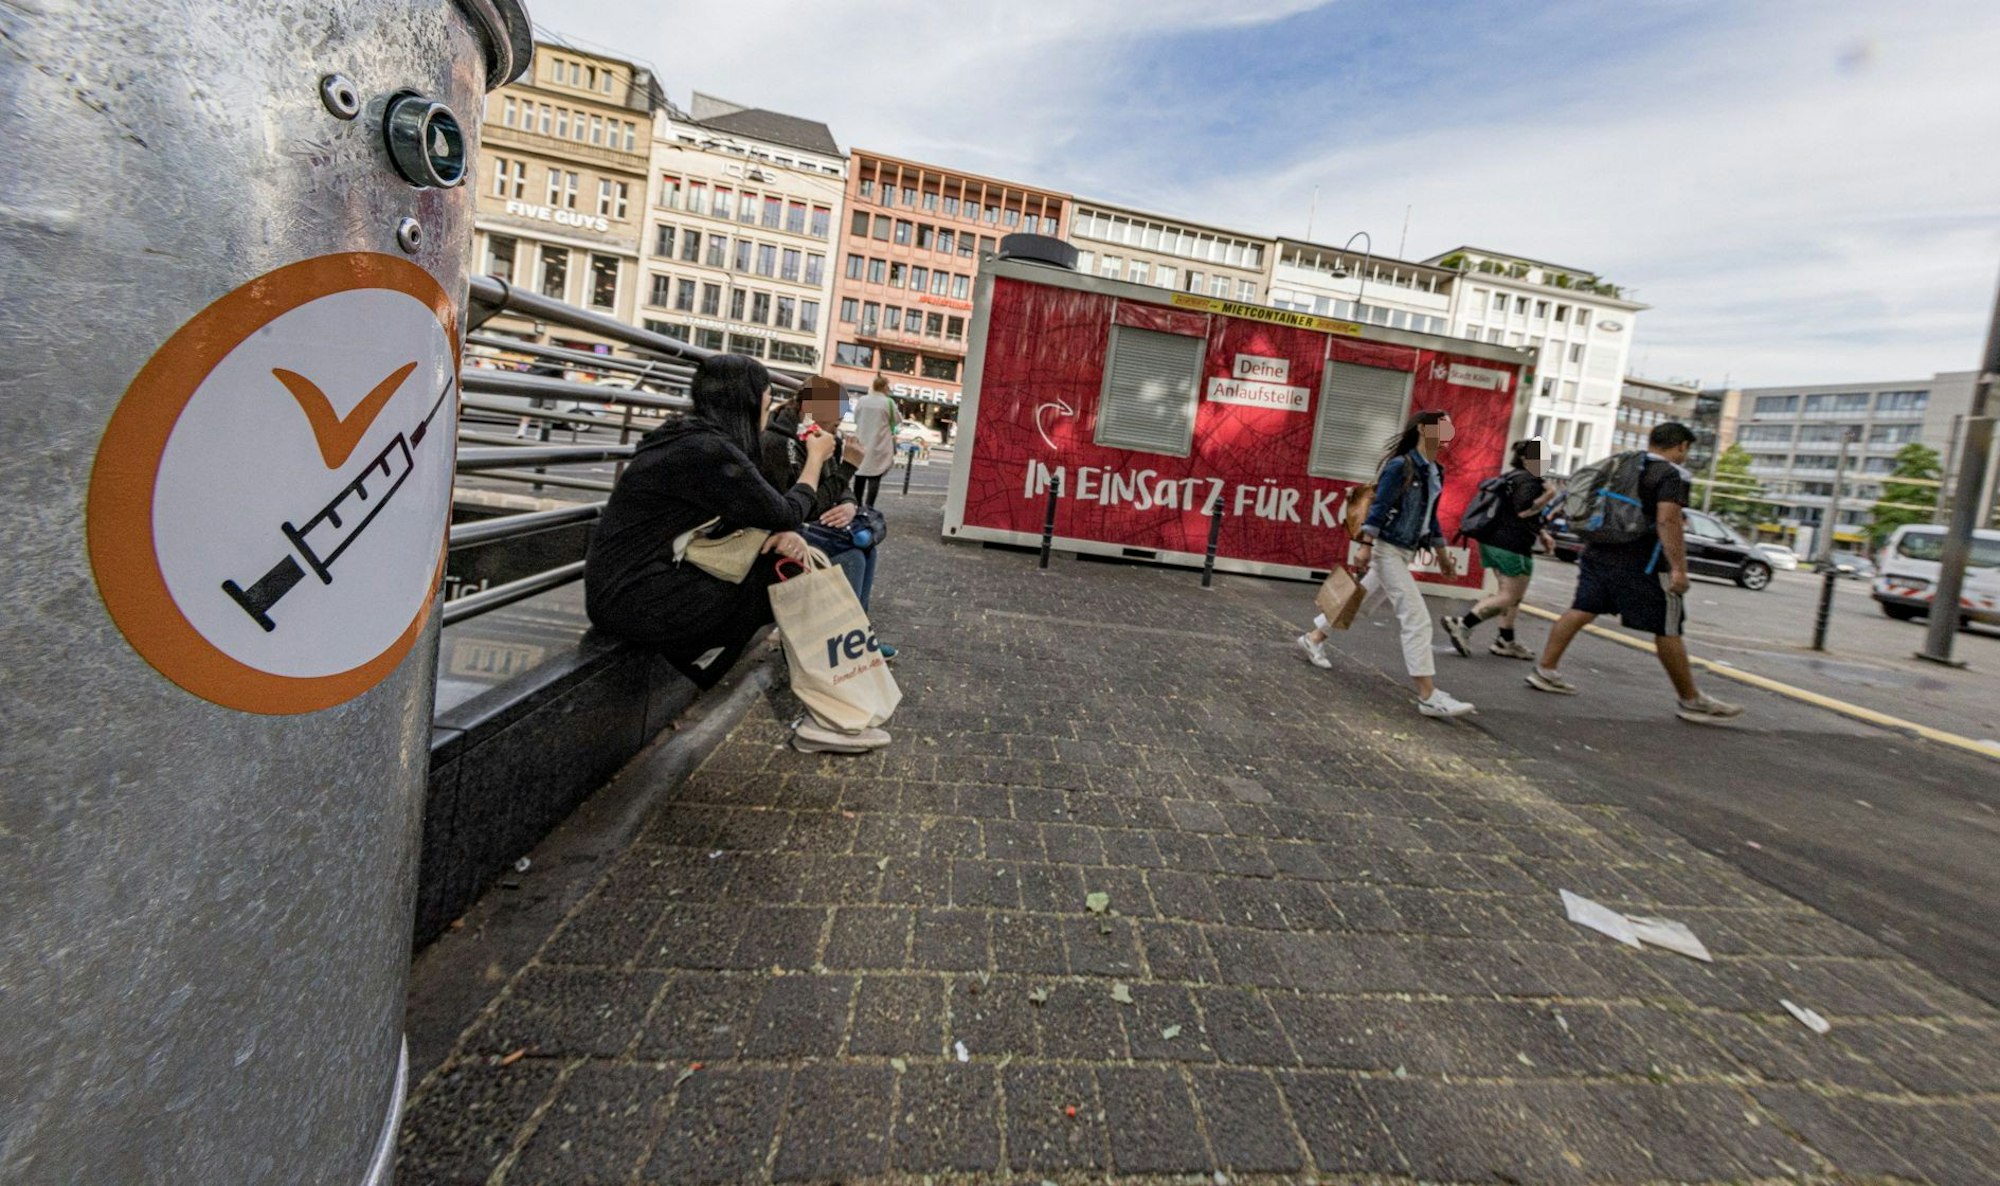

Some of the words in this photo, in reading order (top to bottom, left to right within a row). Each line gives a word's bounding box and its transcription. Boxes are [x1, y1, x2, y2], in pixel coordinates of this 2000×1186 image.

[506, 200, 551, 221] FIVE
[554, 210, 609, 232] GUYS
[1221, 303, 1314, 327] MIETCONTAINER
[1240, 359, 1284, 378] Deine
[893, 383, 948, 403] STAR
[1213, 382, 1303, 406] Anlaufstelle
[1024, 459, 1066, 499] IM
[1233, 478, 1301, 523] FÜR
